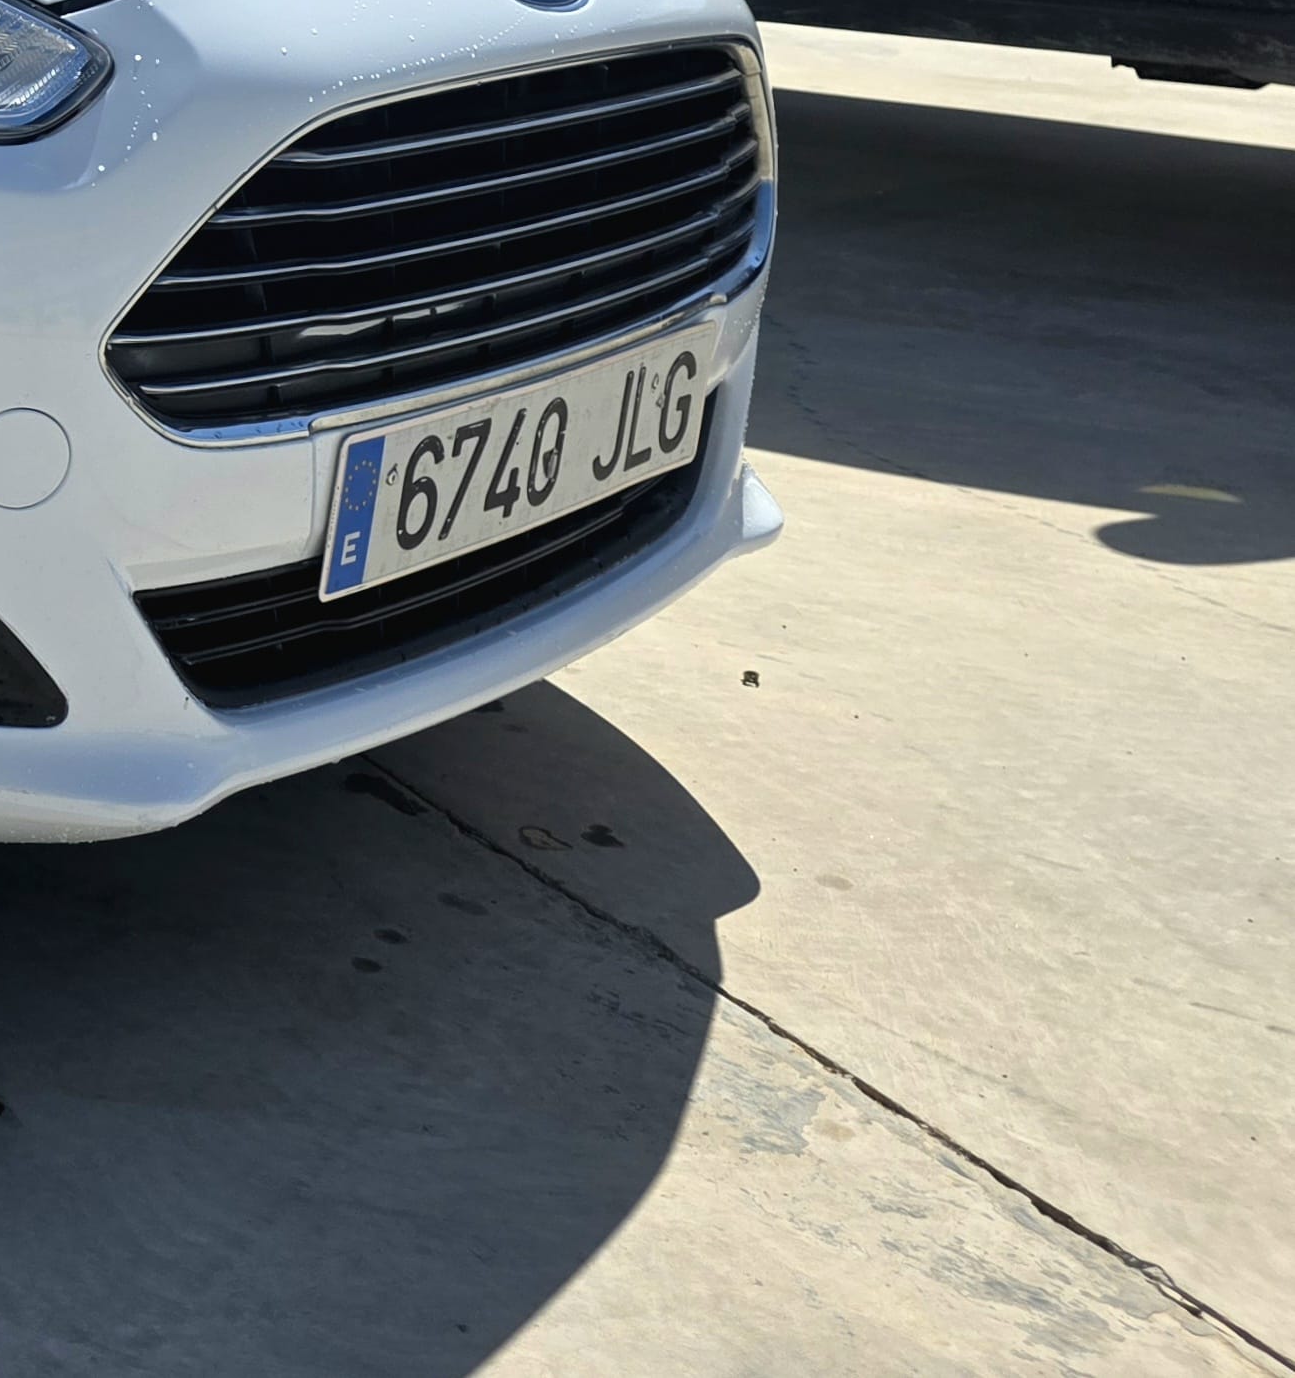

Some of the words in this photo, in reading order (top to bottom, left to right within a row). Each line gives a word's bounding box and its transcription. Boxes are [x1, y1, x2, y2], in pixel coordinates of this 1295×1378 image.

[340, 531, 361, 566] E
[396, 396, 569, 551] 6740
[592, 350, 698, 481] JLG
